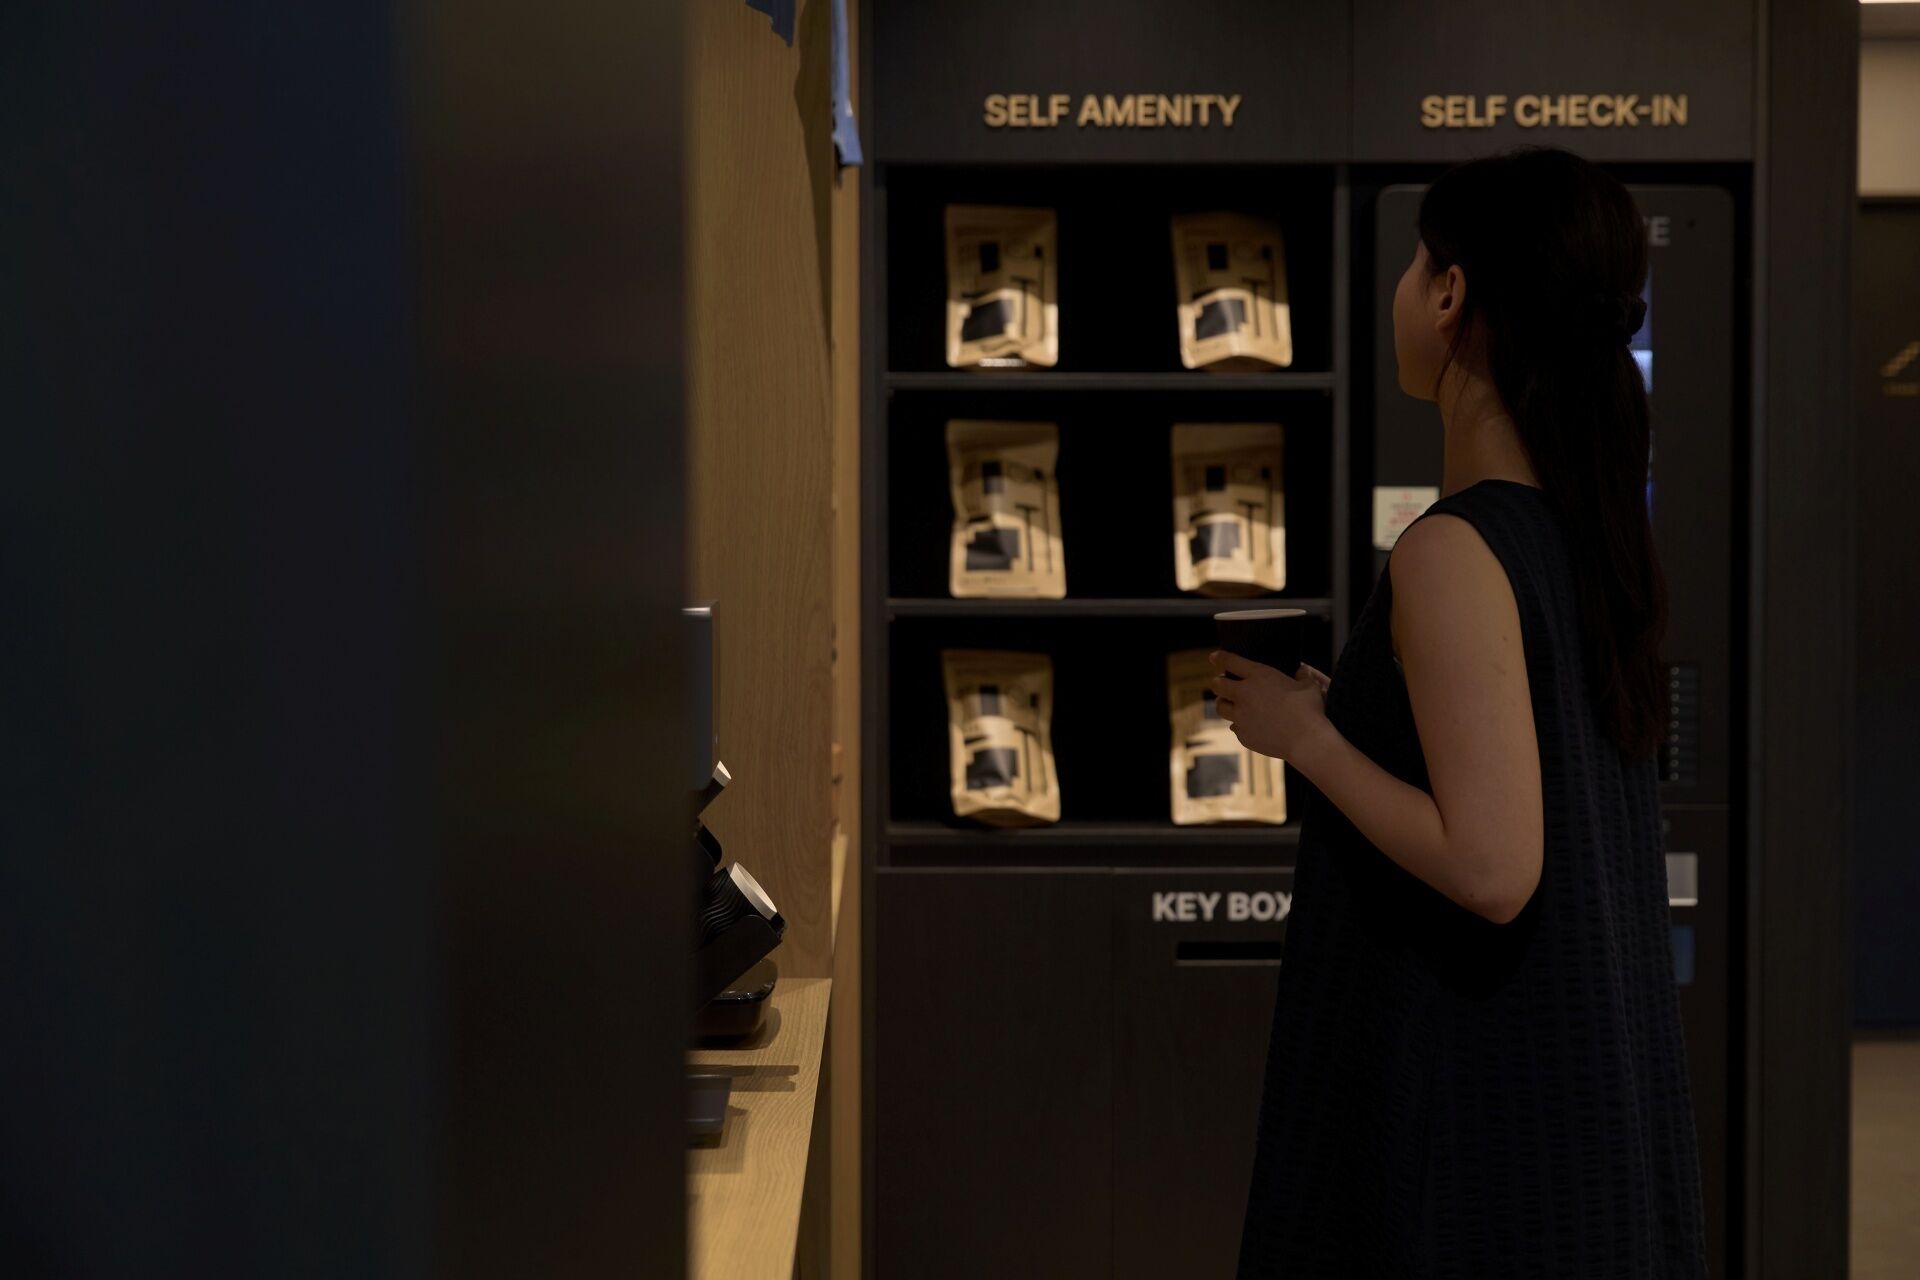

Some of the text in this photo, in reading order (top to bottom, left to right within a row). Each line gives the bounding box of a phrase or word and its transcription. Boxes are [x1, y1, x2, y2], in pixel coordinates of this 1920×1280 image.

[983, 93, 1242, 128] SELF AMENITY
[1420, 93, 1688, 128] SELF CHECK-IN
[1152, 891, 1293, 922] KEY BOX
